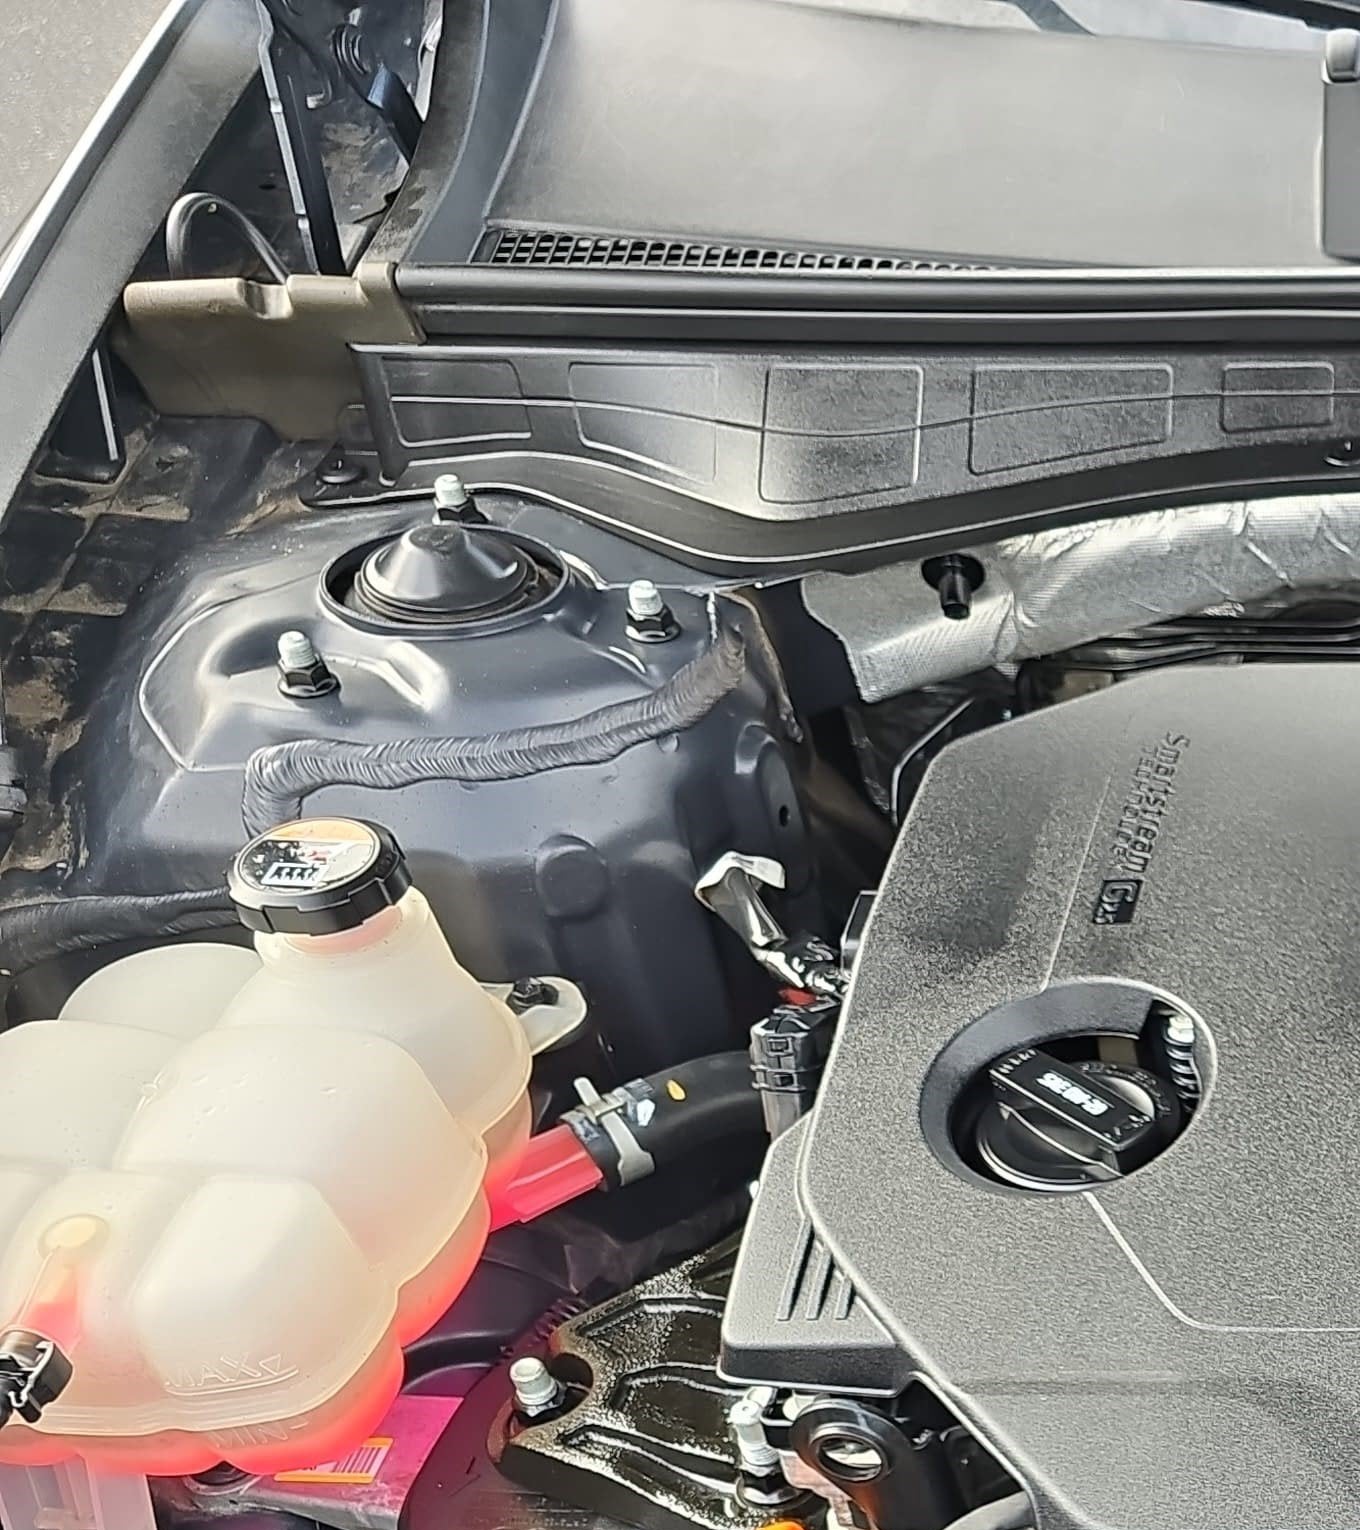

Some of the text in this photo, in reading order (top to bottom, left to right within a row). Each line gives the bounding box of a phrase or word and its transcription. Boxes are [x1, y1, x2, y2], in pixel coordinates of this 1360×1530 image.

[1122, 731, 1190, 873] Smartstream
[166, 1354, 262, 1388] MAX
[208, 1426, 289, 1448] MIN
